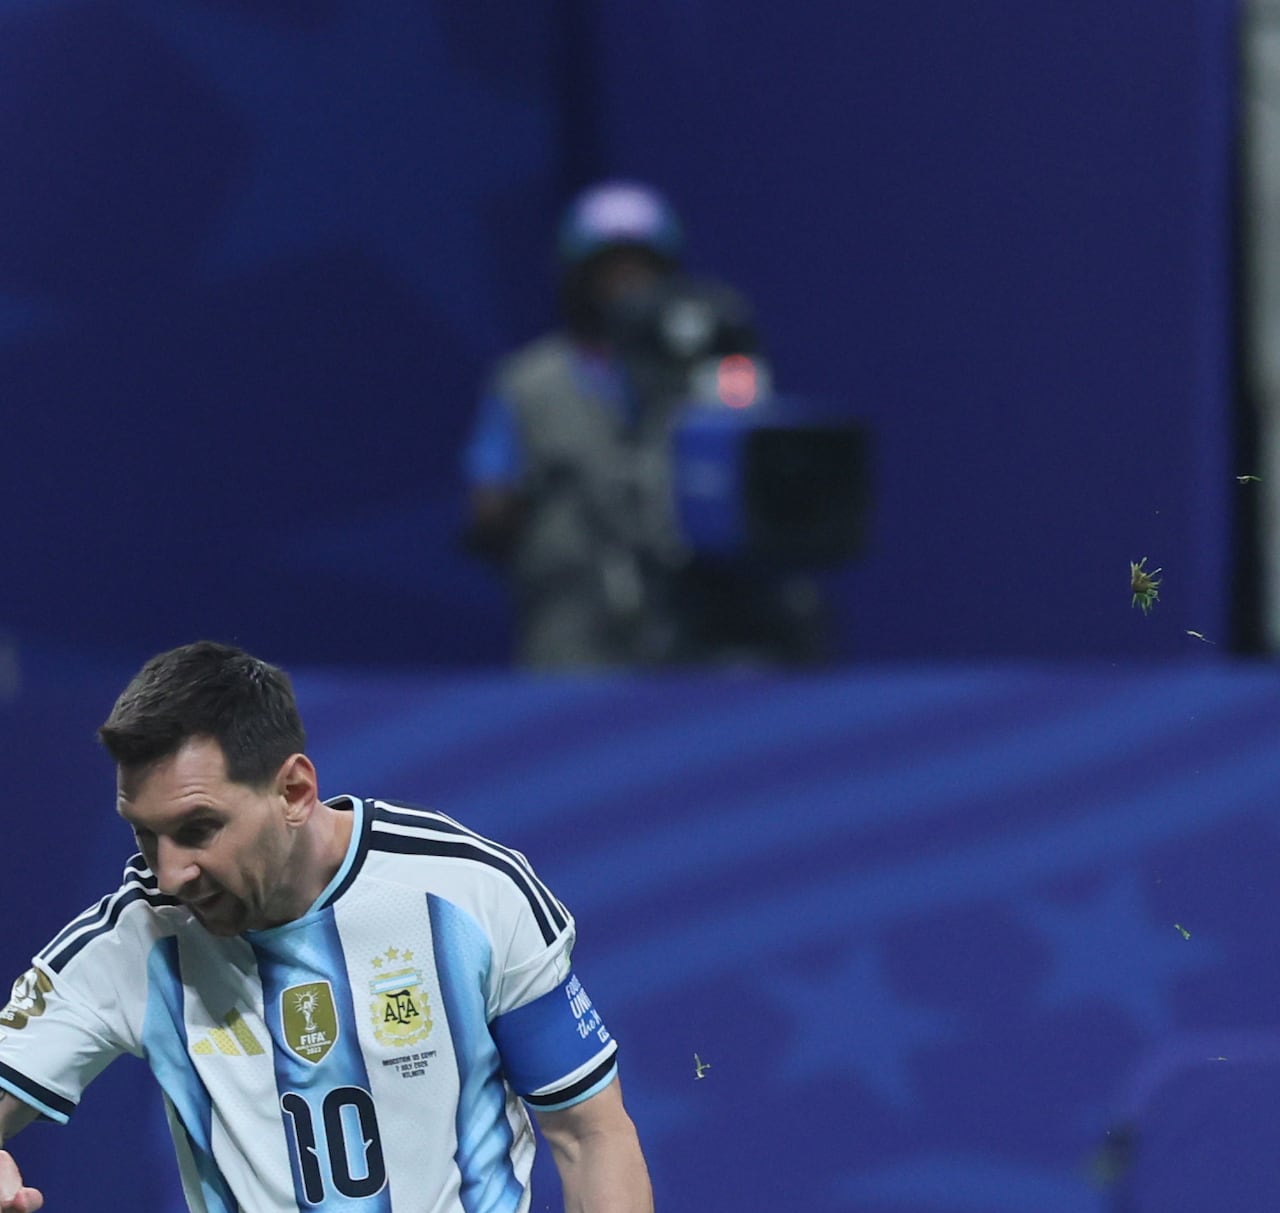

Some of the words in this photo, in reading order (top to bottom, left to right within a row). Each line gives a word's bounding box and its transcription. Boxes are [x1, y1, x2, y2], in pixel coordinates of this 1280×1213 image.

[384, 989, 419, 1024] AFA
[300, 1031, 326, 1046] FIFA
[281, 1086, 387, 1205] 10
